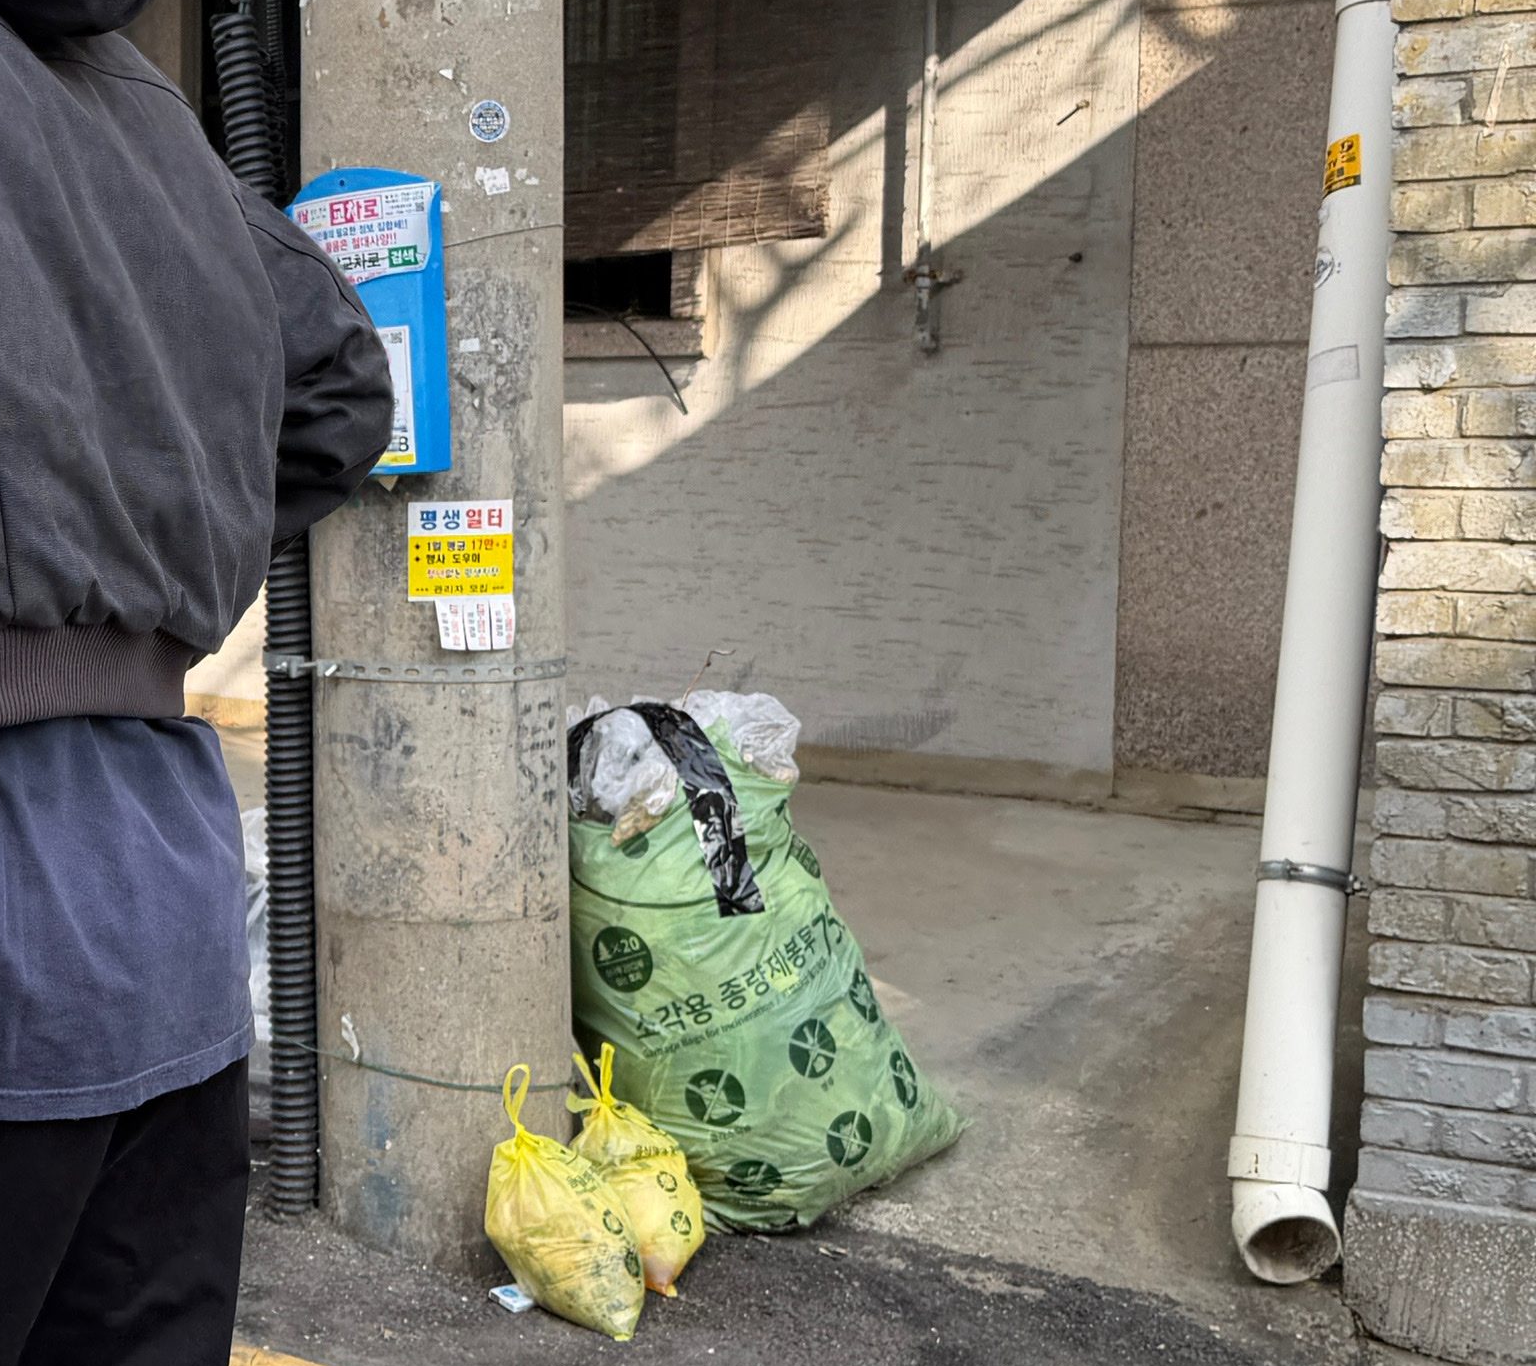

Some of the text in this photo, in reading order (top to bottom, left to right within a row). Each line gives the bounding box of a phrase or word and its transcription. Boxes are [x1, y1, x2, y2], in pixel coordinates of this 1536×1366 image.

[337, 247, 416, 270] 교차로 검색
[718, 925, 815, 1011] 종량제봉투
